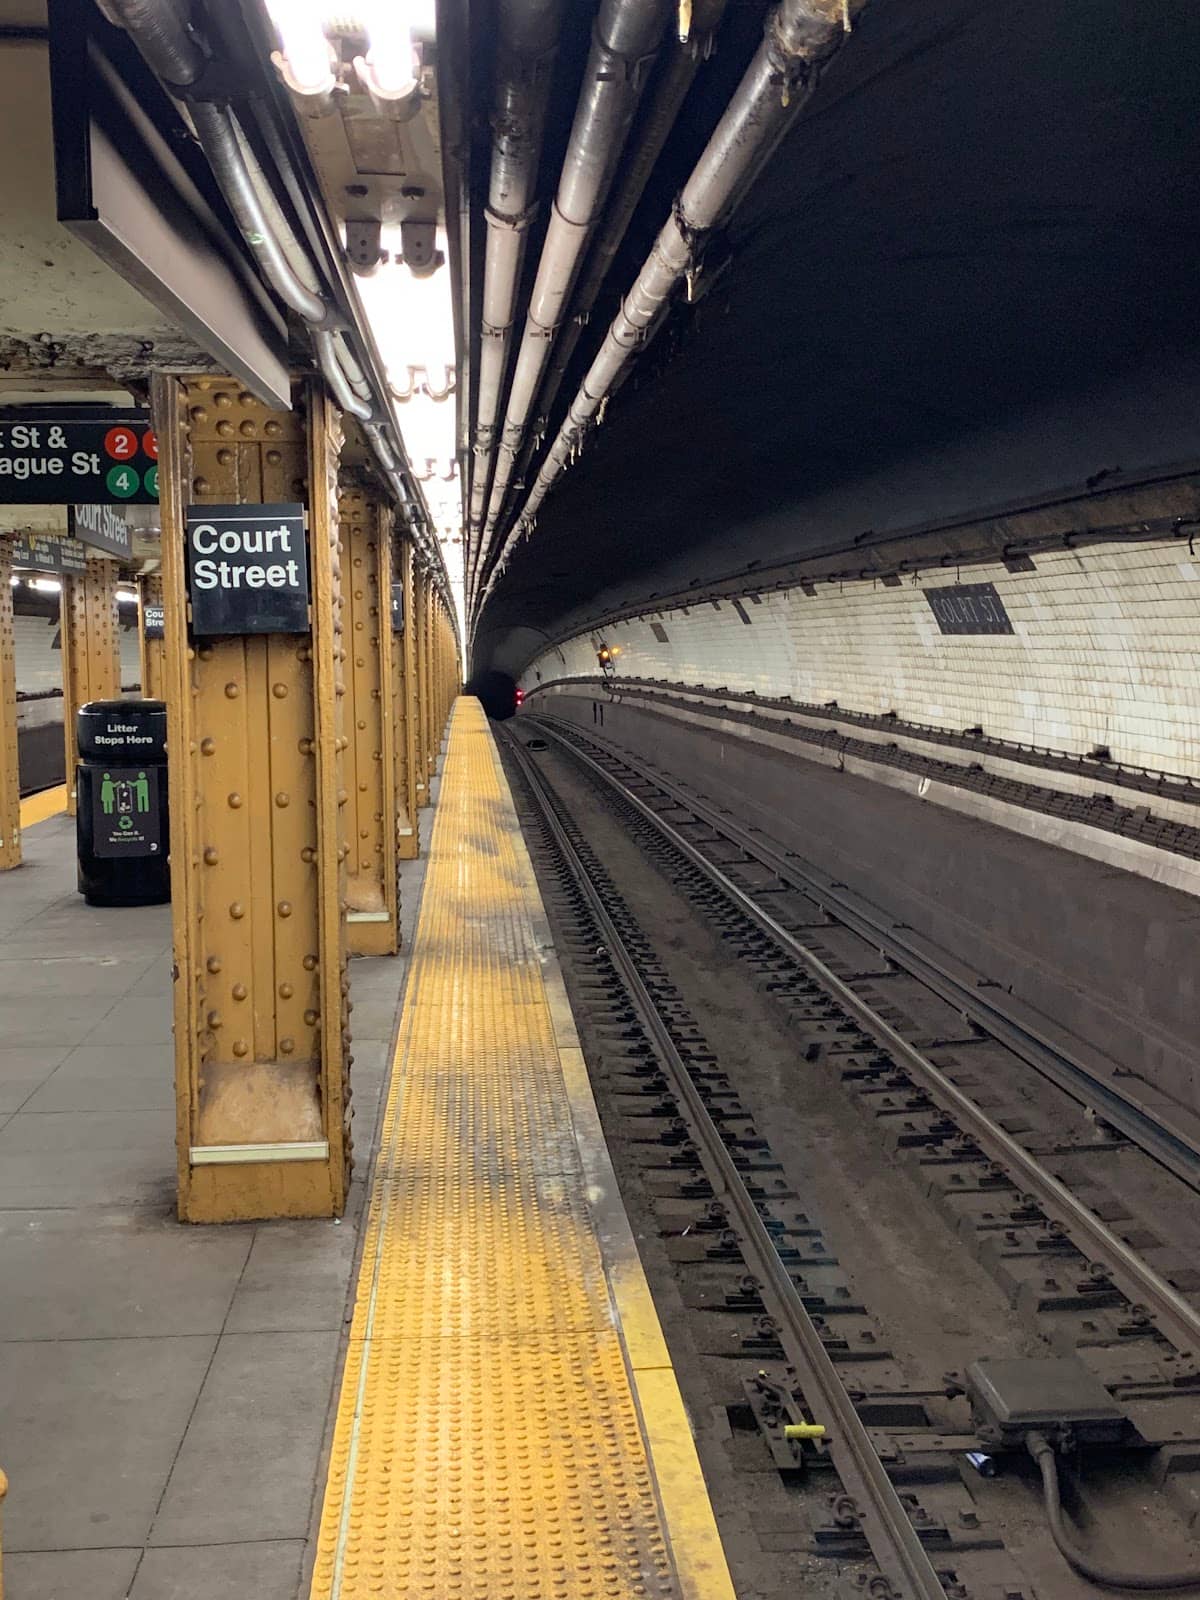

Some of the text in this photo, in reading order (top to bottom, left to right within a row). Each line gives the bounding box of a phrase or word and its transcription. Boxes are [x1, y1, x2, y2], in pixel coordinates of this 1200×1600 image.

[11, 426, 40, 449] St
[47, 426, 68, 449] &
[114, 435, 129, 453] 2
[71, 451, 100, 475] St
[115, 472, 130, 490] 4
[192, 525, 292, 555] Court
[194, 559, 300, 589] Street
[107, 724, 138, 733] Litter
[94, 735, 153, 746] Stops Here
